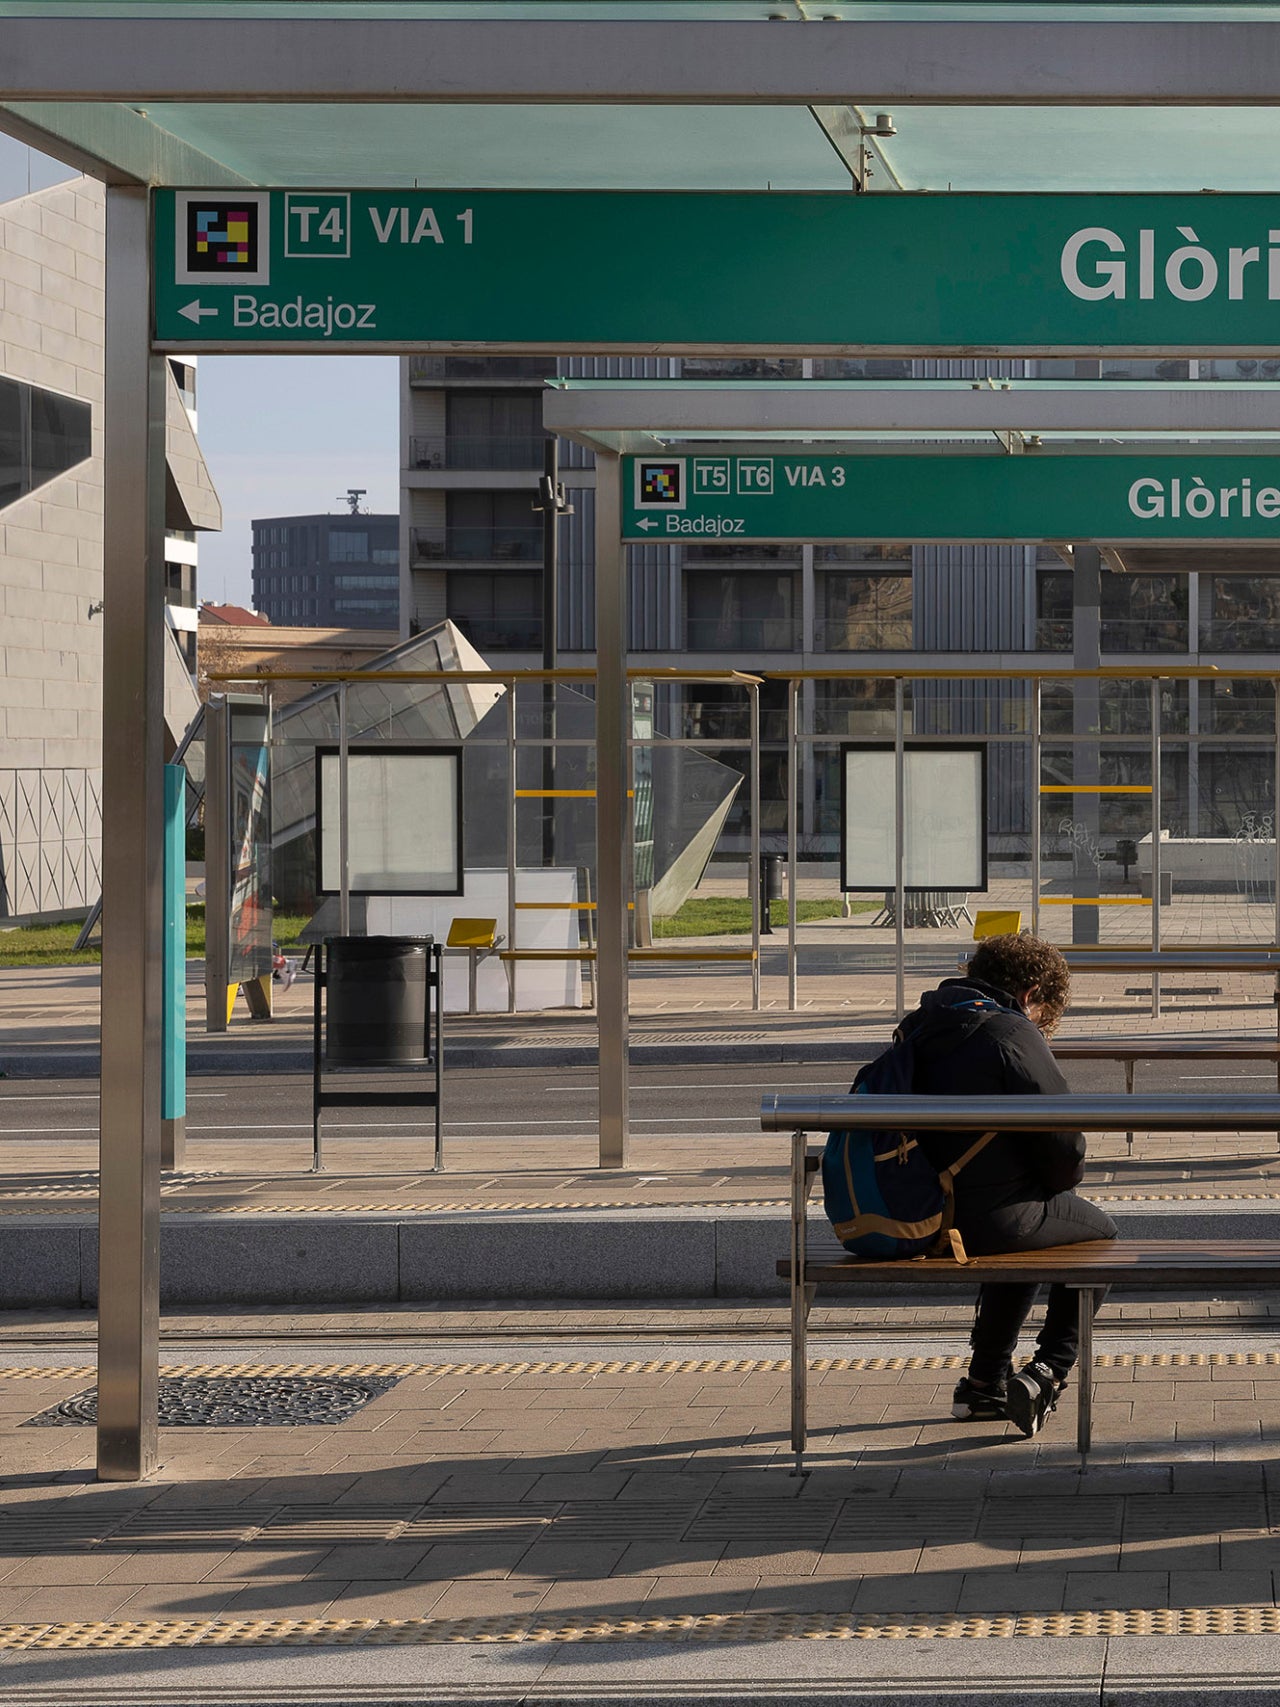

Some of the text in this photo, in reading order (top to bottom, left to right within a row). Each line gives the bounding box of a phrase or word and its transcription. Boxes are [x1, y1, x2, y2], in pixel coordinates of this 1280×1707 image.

[290, 206, 473, 244] T4 VIA 1
[233, 295, 377, 336] Badajoz
[697, 466, 845, 487] T5 T6 VIA 3
[666, 514, 745, 536] Badajoz
